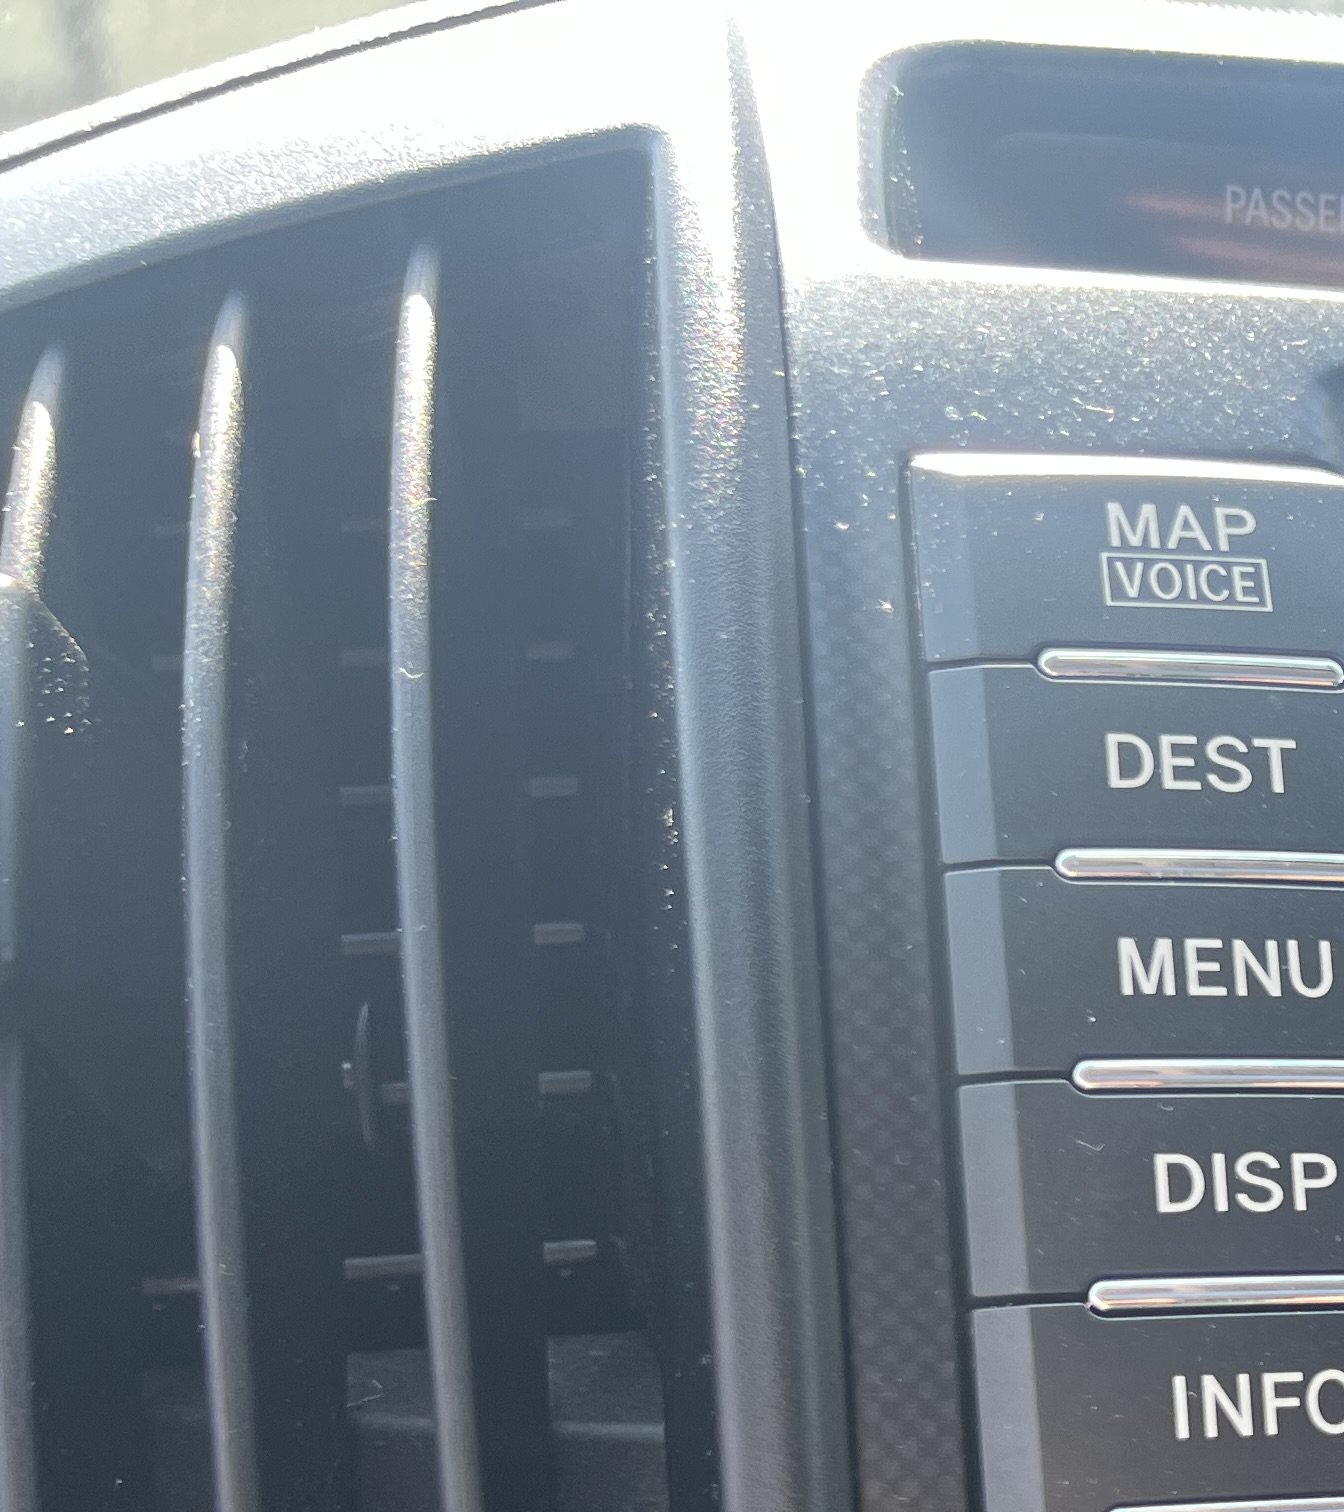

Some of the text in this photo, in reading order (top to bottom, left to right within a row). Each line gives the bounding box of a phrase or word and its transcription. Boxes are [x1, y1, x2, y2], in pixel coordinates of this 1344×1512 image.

[1106, 502, 1258, 552] MAP
[1114, 560, 1261, 603] VOICE
[1105, 733, 1297, 793] DEST
[1117, 937, 1335, 998] MENU
[1154, 1151, 1339, 1214] DISP
